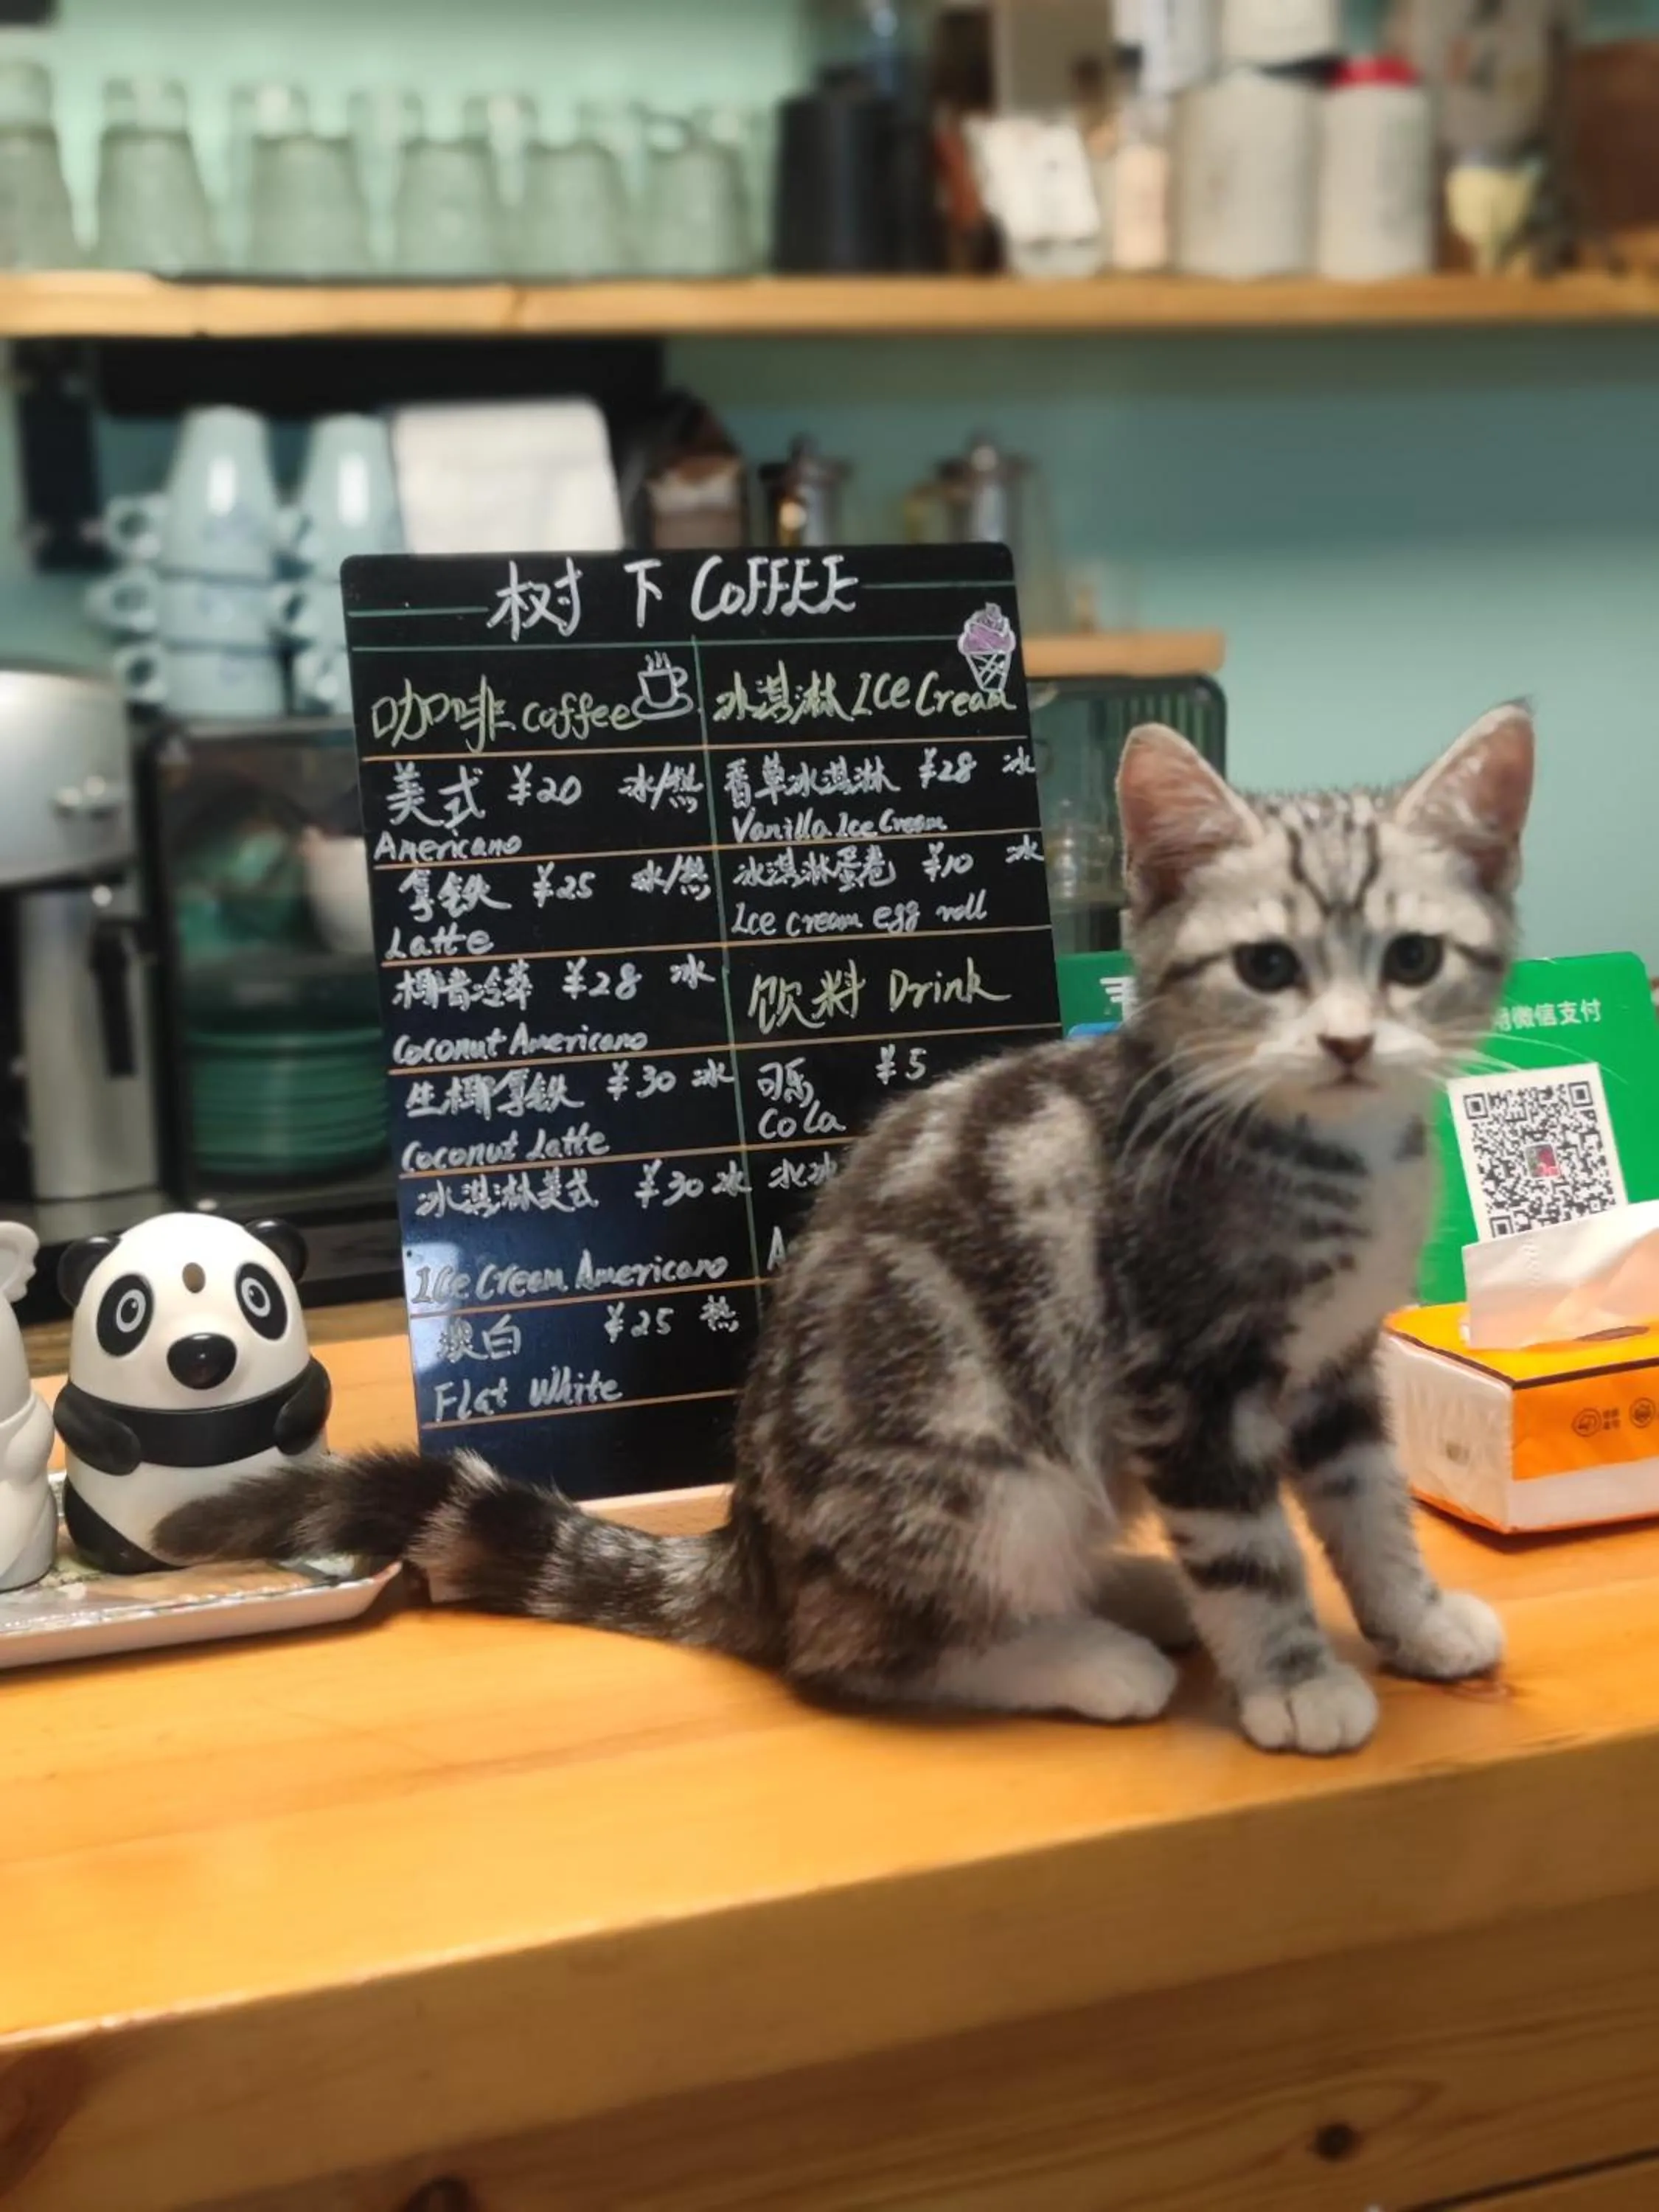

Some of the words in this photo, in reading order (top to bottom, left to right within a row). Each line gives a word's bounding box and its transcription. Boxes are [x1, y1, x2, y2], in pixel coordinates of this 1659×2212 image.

[372, 674, 516, 754] 咖啡
[712, 660, 855, 725] 冰淇淋
[386, 761, 487, 835] 美式
[507, 762, 582, 807] ¥20
[399, 868, 512, 922] 拿铁
[532, 861, 596, 908] ¥25
[872, 899, 921, 933] egg
[936, 888, 987, 923] roll
[385, 922, 494, 959] Latte
[562, 957, 641, 1000] ¥28
[748, 959, 866, 1032] 饮料
[889, 956, 1012, 1012] Drink
[392, 1027, 507, 1065] Coconut
[607, 1060, 676, 1102] ¥30
[401, 1130, 520, 1173] Coconut
[635, 1158, 704, 1208] ¥30
[603, 1301, 674, 1344] ¥25
[434, 1377, 509, 1422] Flat
[529, 1366, 623, 1408] White
